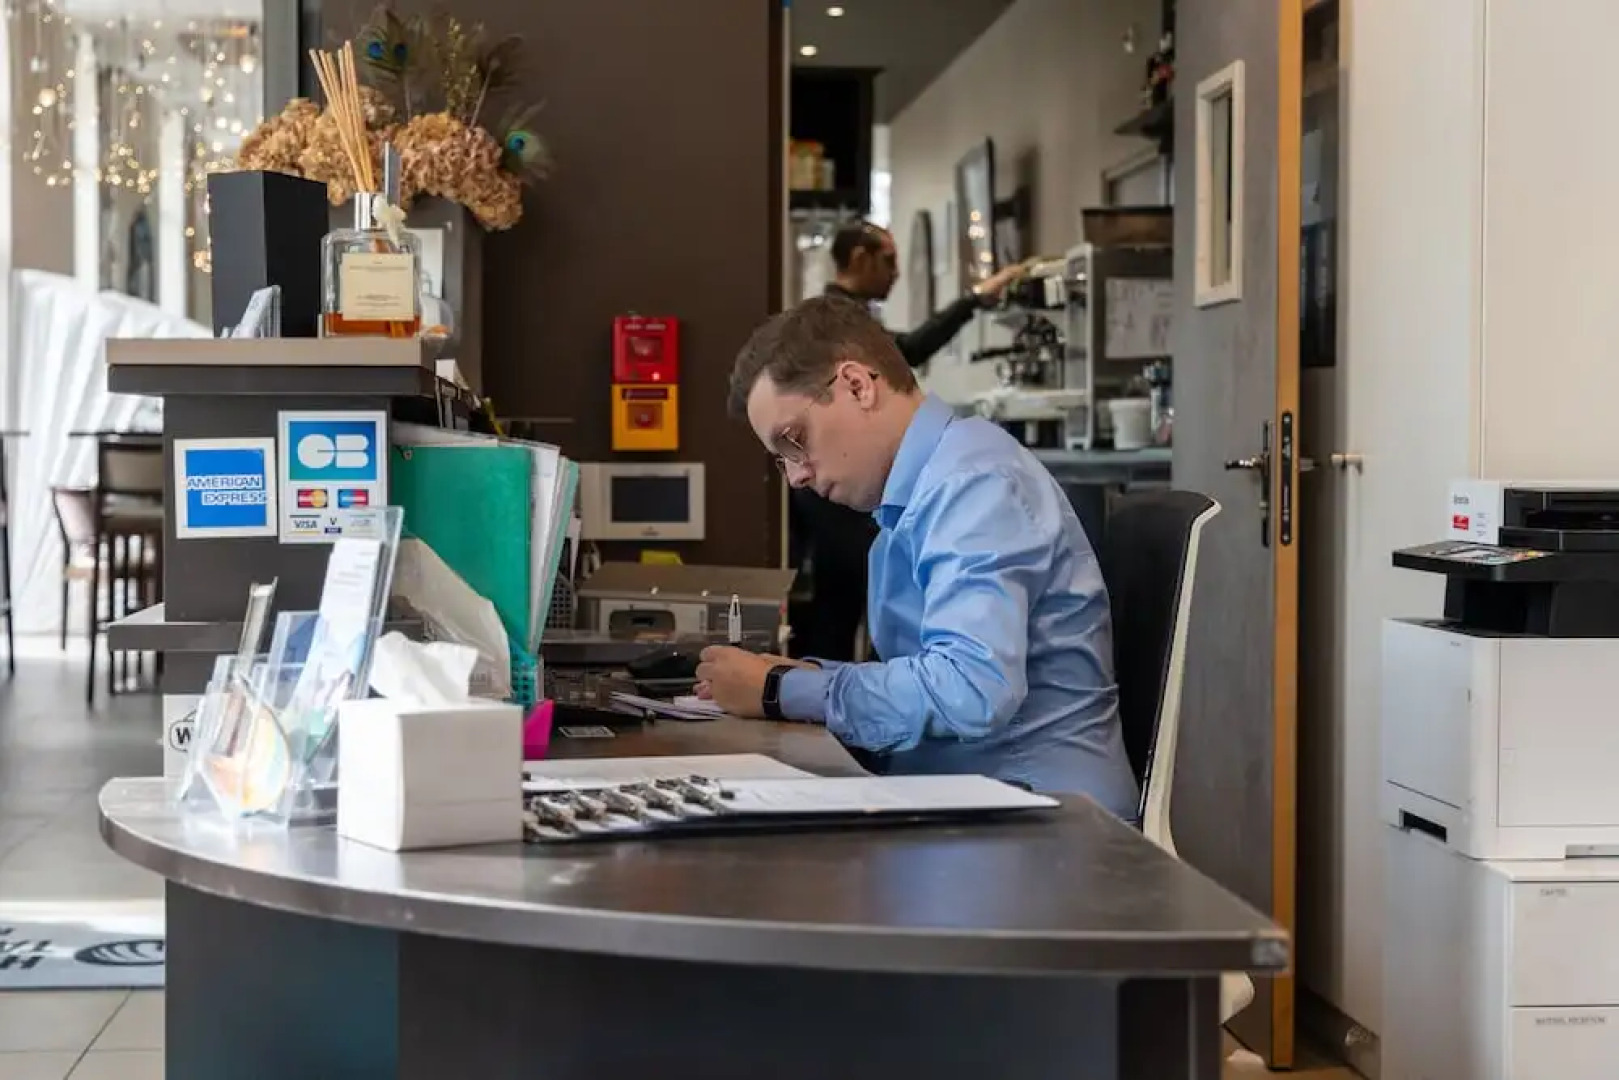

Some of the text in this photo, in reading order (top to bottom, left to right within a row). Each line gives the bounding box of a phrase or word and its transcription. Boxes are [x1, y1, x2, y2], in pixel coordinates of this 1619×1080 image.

[187, 476, 260, 488] AMERICAN
[204, 492, 268, 503] EXPRESS
[293, 520, 318, 529] VISA
